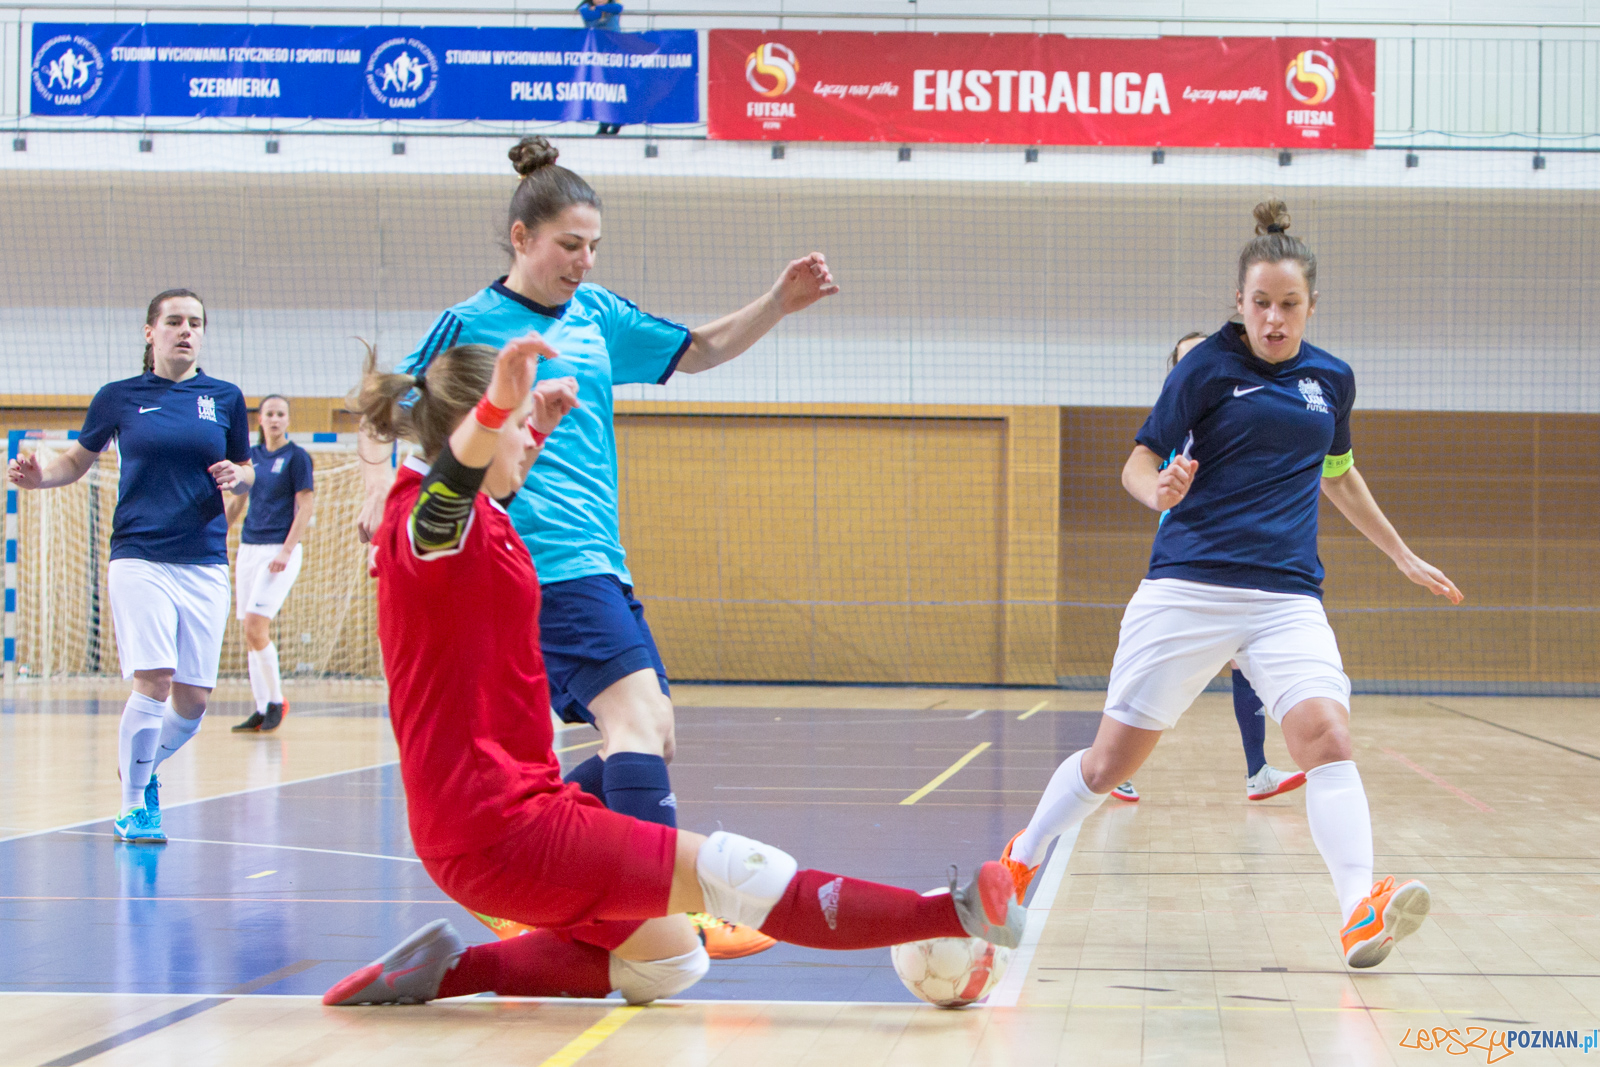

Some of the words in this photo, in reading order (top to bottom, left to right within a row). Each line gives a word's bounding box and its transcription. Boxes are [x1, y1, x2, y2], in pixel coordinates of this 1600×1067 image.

[111, 46, 156, 61] STUDIUM
[157, 47, 228, 62] WYCHOWANIA
[228, 47, 289, 62] FIZYCZNEGO
[290, 48, 295, 62] I
[296, 48, 335, 63] SPORTU
[336, 49, 361, 63] UAM
[445, 50, 492, 65] STUDIUM
[492, 50, 562, 66] WYCHOWANIA
[564, 51, 623, 67] FIZYCZNEGO
[624, 53, 629, 67] I
[629, 54, 668, 68] SPORTU
[668, 53, 692, 68] UAM
[189, 77, 281, 98] SZERMIERKA
[511, 81, 554, 101] PIŁKA
[556, 81, 627, 103] SIATKOWA
[848, 85, 870, 96] nas
[866, 81, 899, 100] piłka
[912, 68, 1171, 116] EKSTRALIGA
[1217, 90, 1239, 101] nas
[1235, 86, 1268, 105] piłka
[54, 94, 82, 106] UAM
[388, 97, 417, 109] UAM
[746, 101, 797, 118] FUTSAL
[1286, 109, 1336, 126] FUTSAL
[1306, 403, 1329, 414] FUTSAL
